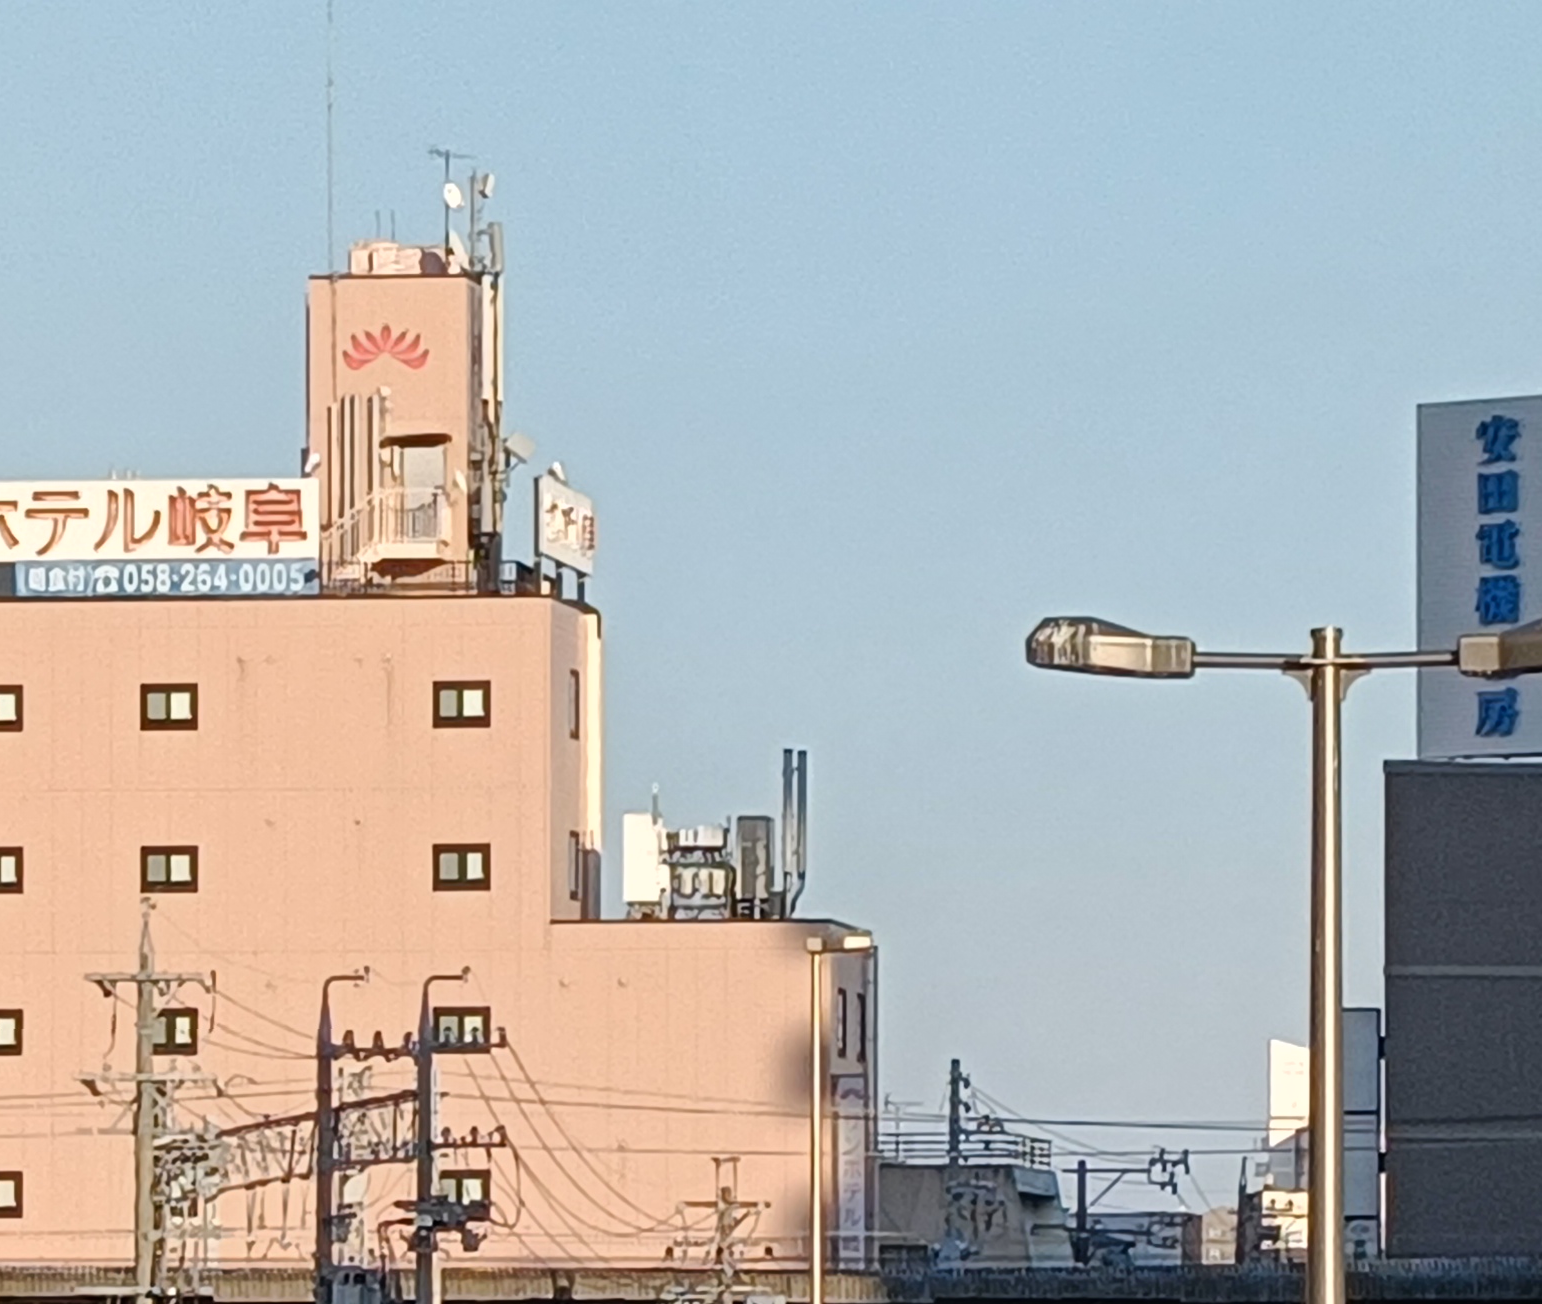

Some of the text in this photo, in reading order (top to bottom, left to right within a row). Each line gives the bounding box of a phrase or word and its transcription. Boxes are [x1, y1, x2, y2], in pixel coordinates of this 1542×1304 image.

[1475, 414, 1521, 737] 安田電機房
